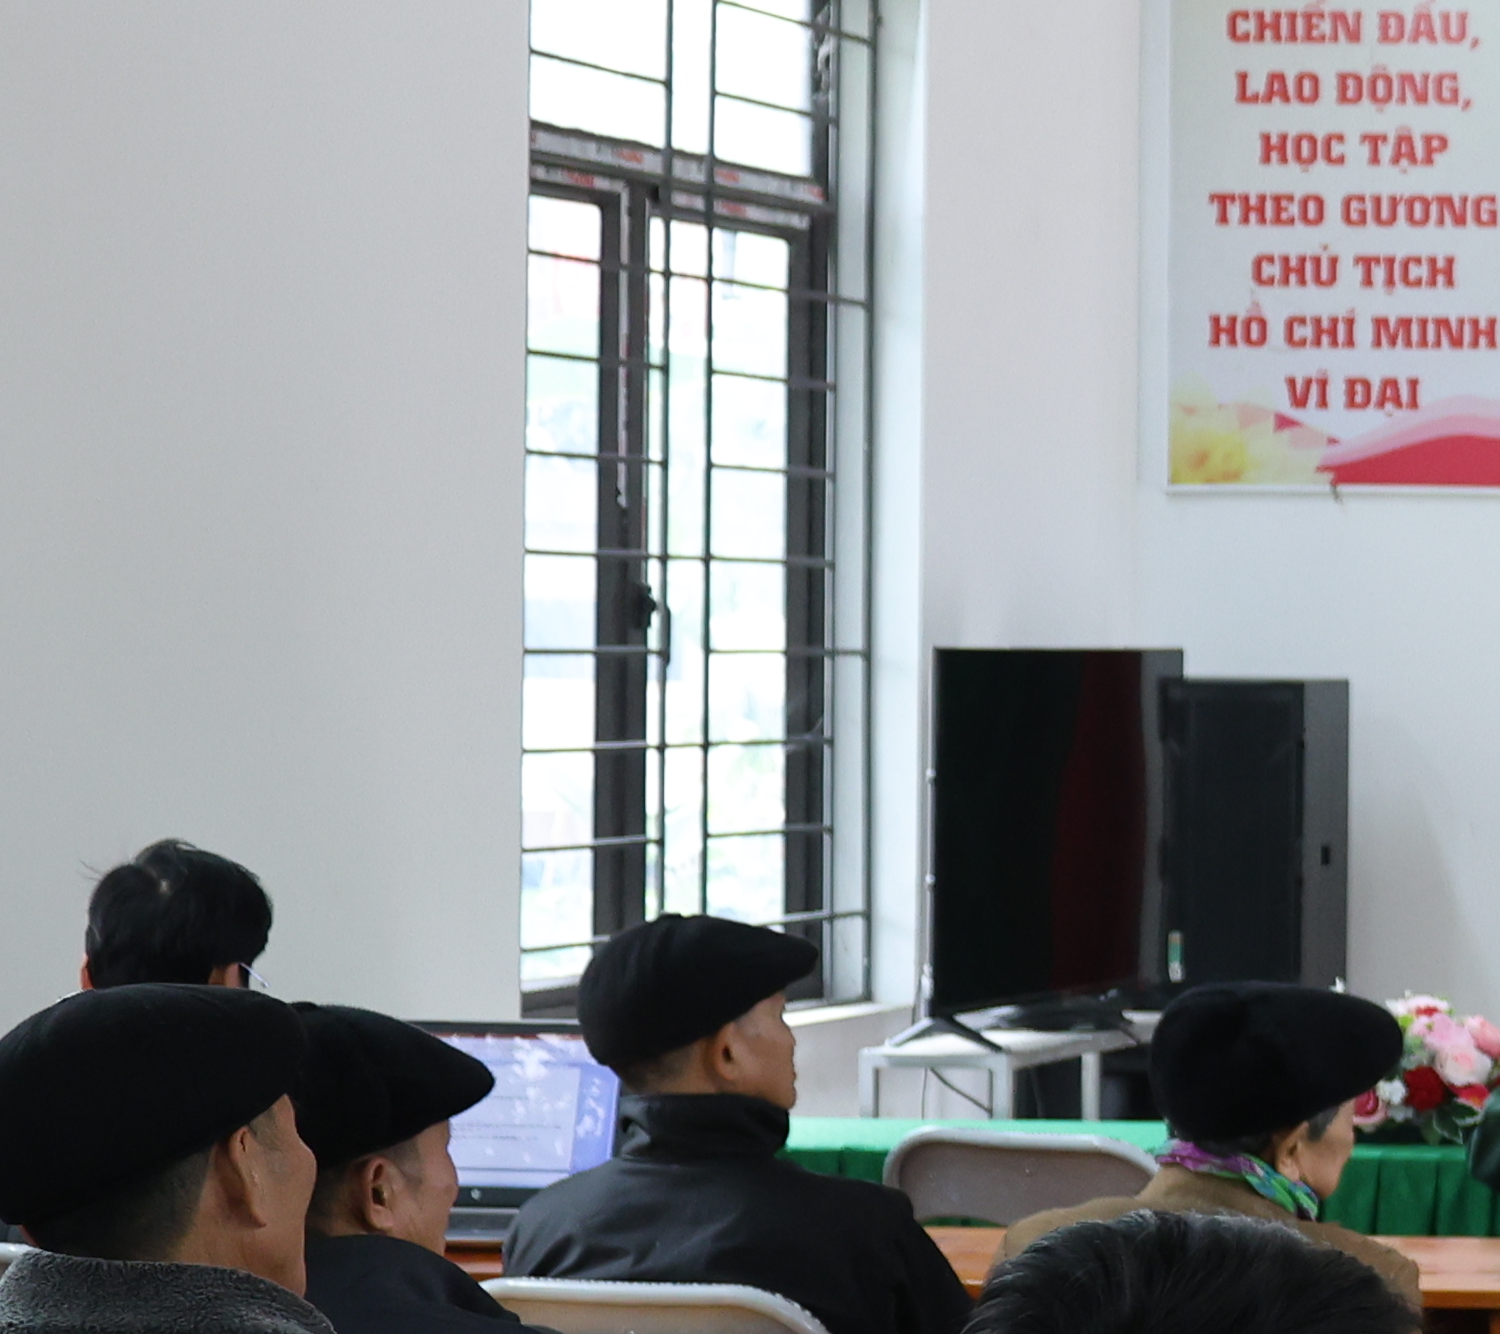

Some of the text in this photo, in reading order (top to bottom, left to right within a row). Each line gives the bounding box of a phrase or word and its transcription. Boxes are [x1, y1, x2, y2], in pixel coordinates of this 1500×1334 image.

[1235, 64, 1472, 112] LAO ĐỘNG,
[1259, 126, 1450, 174] HỌC TẬP
[1208, 192, 1326, 228] THEO
[1251, 244, 1456, 294] CHỦ TỊCH
[1283, 307, 1357, 350] CHÍ
[1371, 315, 1498, 351] MINH
[1344, 376, 1421, 416] ĐẠI
